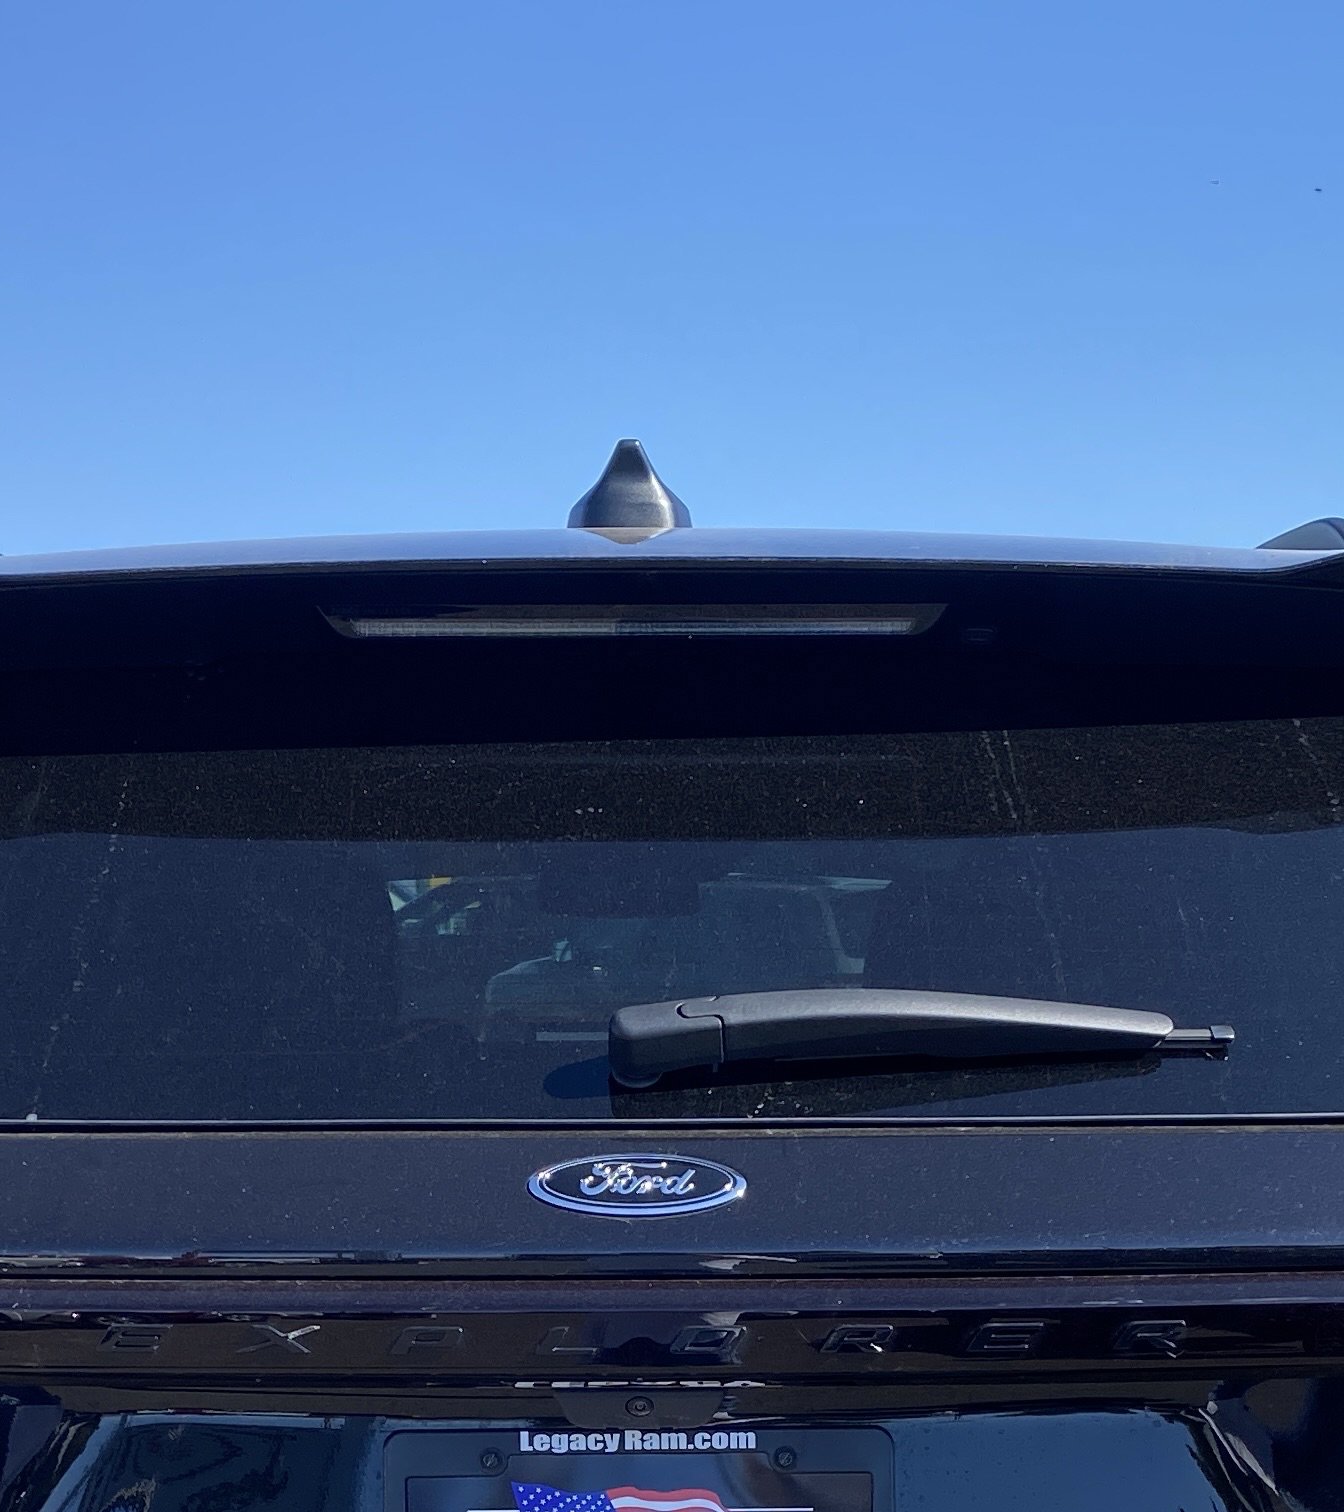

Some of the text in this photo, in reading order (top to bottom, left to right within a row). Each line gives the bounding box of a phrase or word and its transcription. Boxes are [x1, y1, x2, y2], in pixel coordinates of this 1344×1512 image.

[580, 1162, 697, 1196] Ford
[96, 1319, 1188, 1358] EXPLORER
[519, 1430, 757, 1453] Legacy Ram.com
